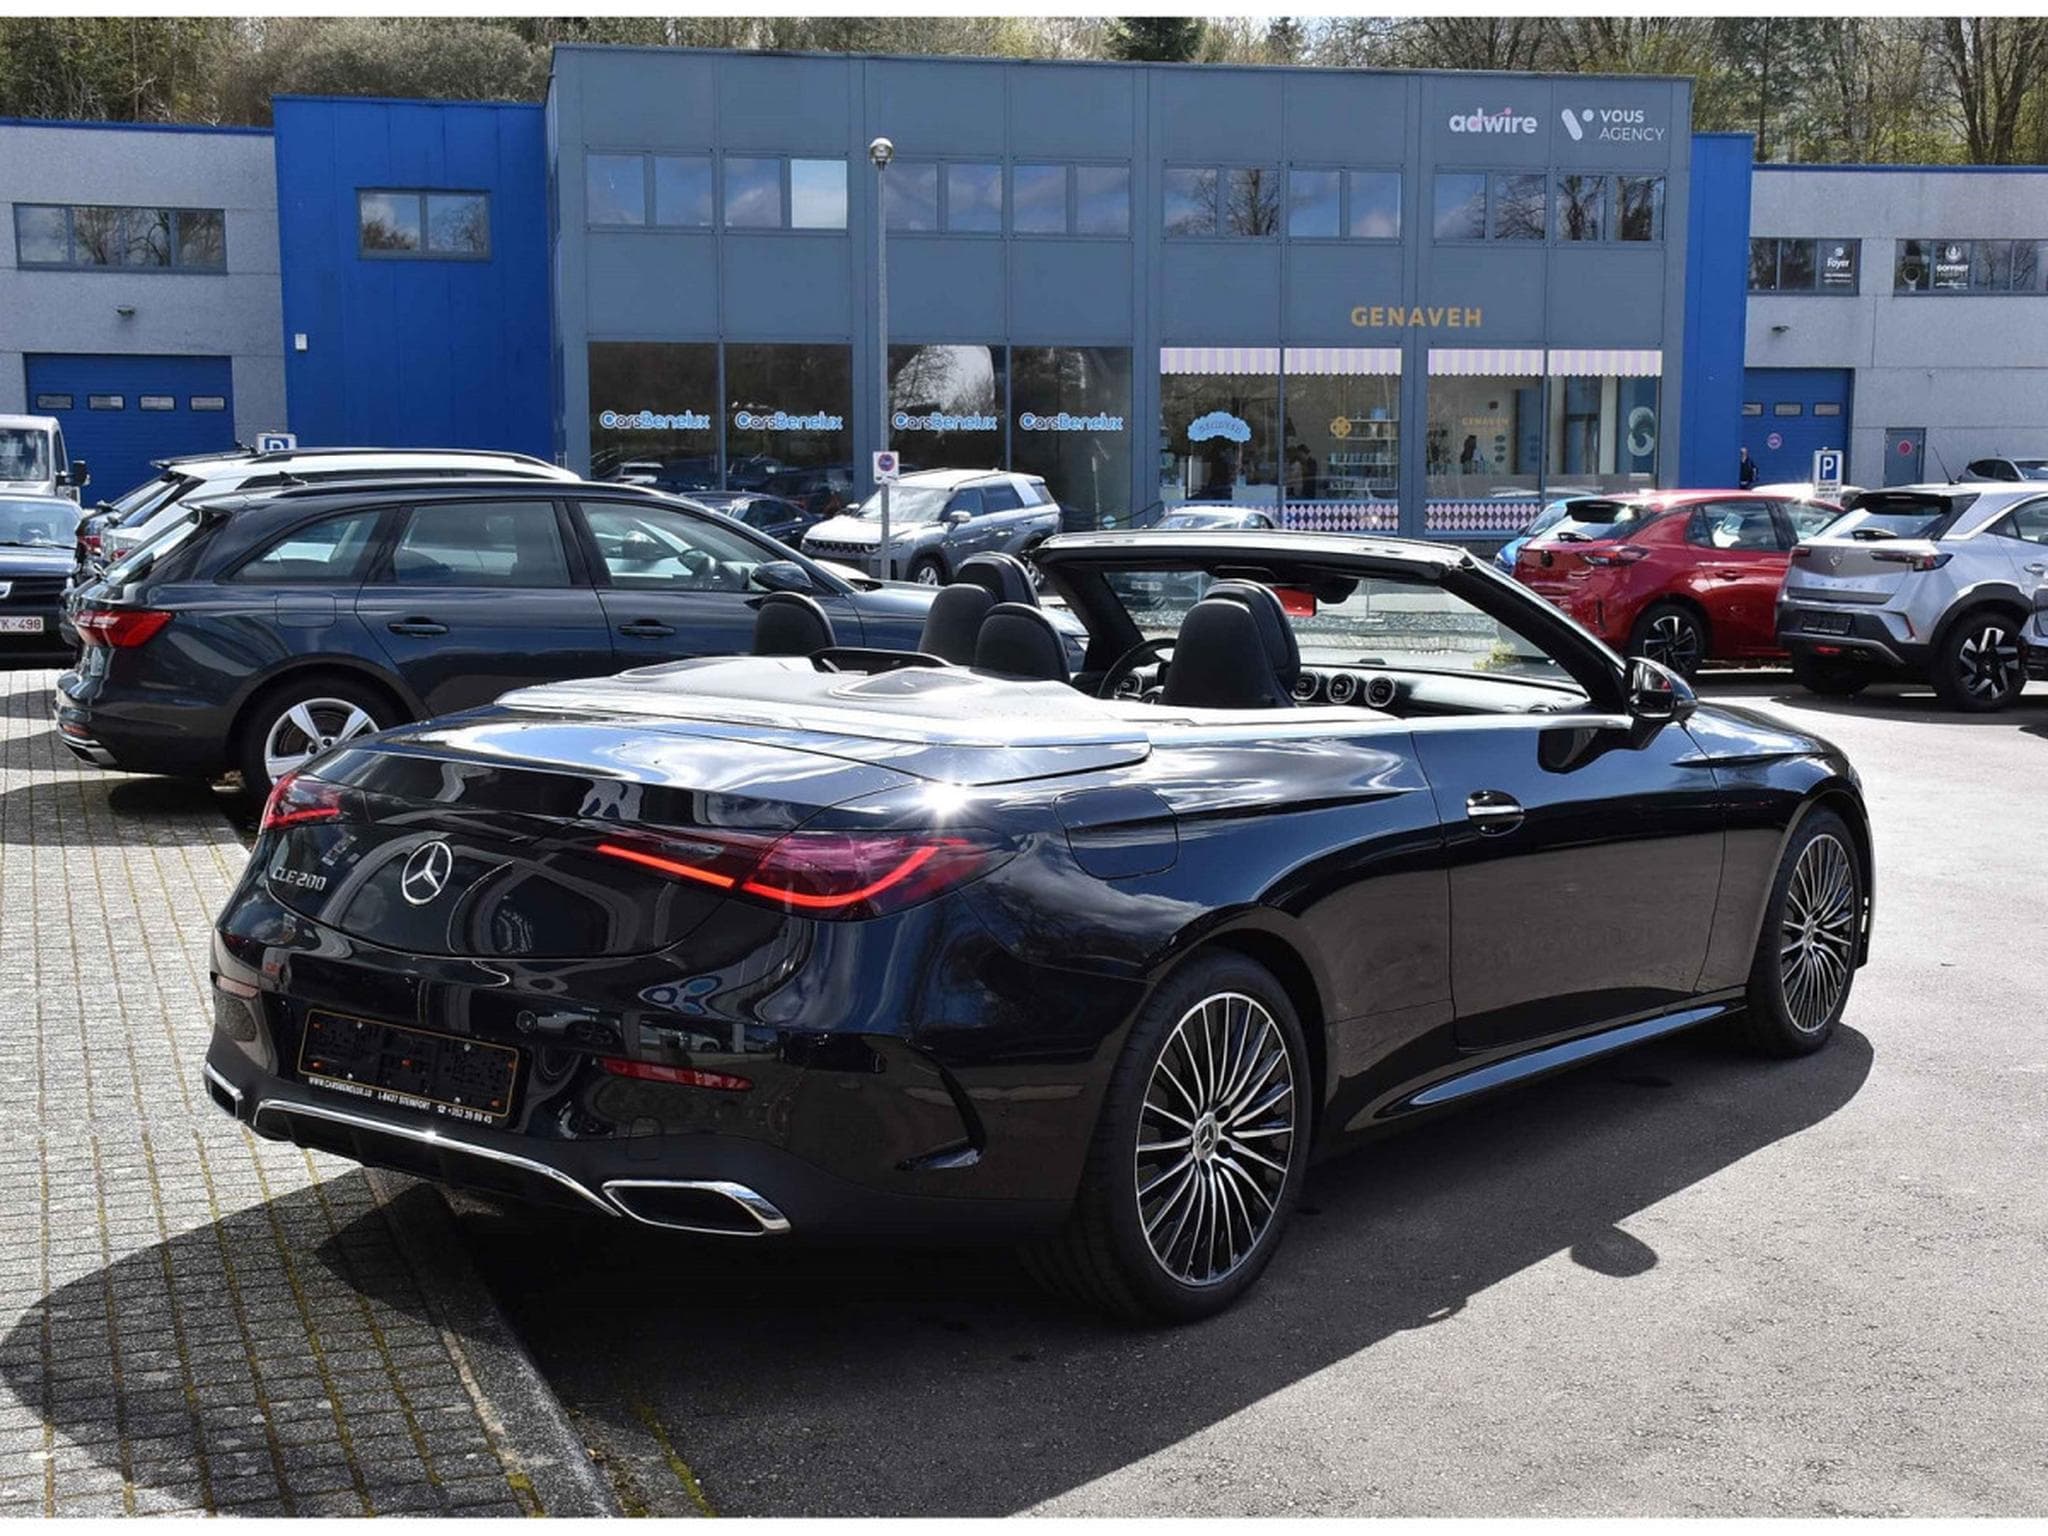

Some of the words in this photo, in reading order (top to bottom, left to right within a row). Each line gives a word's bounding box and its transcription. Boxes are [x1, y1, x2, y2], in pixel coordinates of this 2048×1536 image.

[1449, 107, 1538, 133] adwire
[1600, 109, 1645, 123] VOUS
[1599, 127, 1665, 141] AGENCY
[1350, 305, 1483, 328] GENAVEH
[600, 409, 711, 430] CarsBenelux
[735, 410, 844, 431] CarsBenelux
[891, 411, 998, 431] CarsBenelux
[1019, 412, 1124, 431] CarsBenelux
[1822, 456, 1834, 478] P
